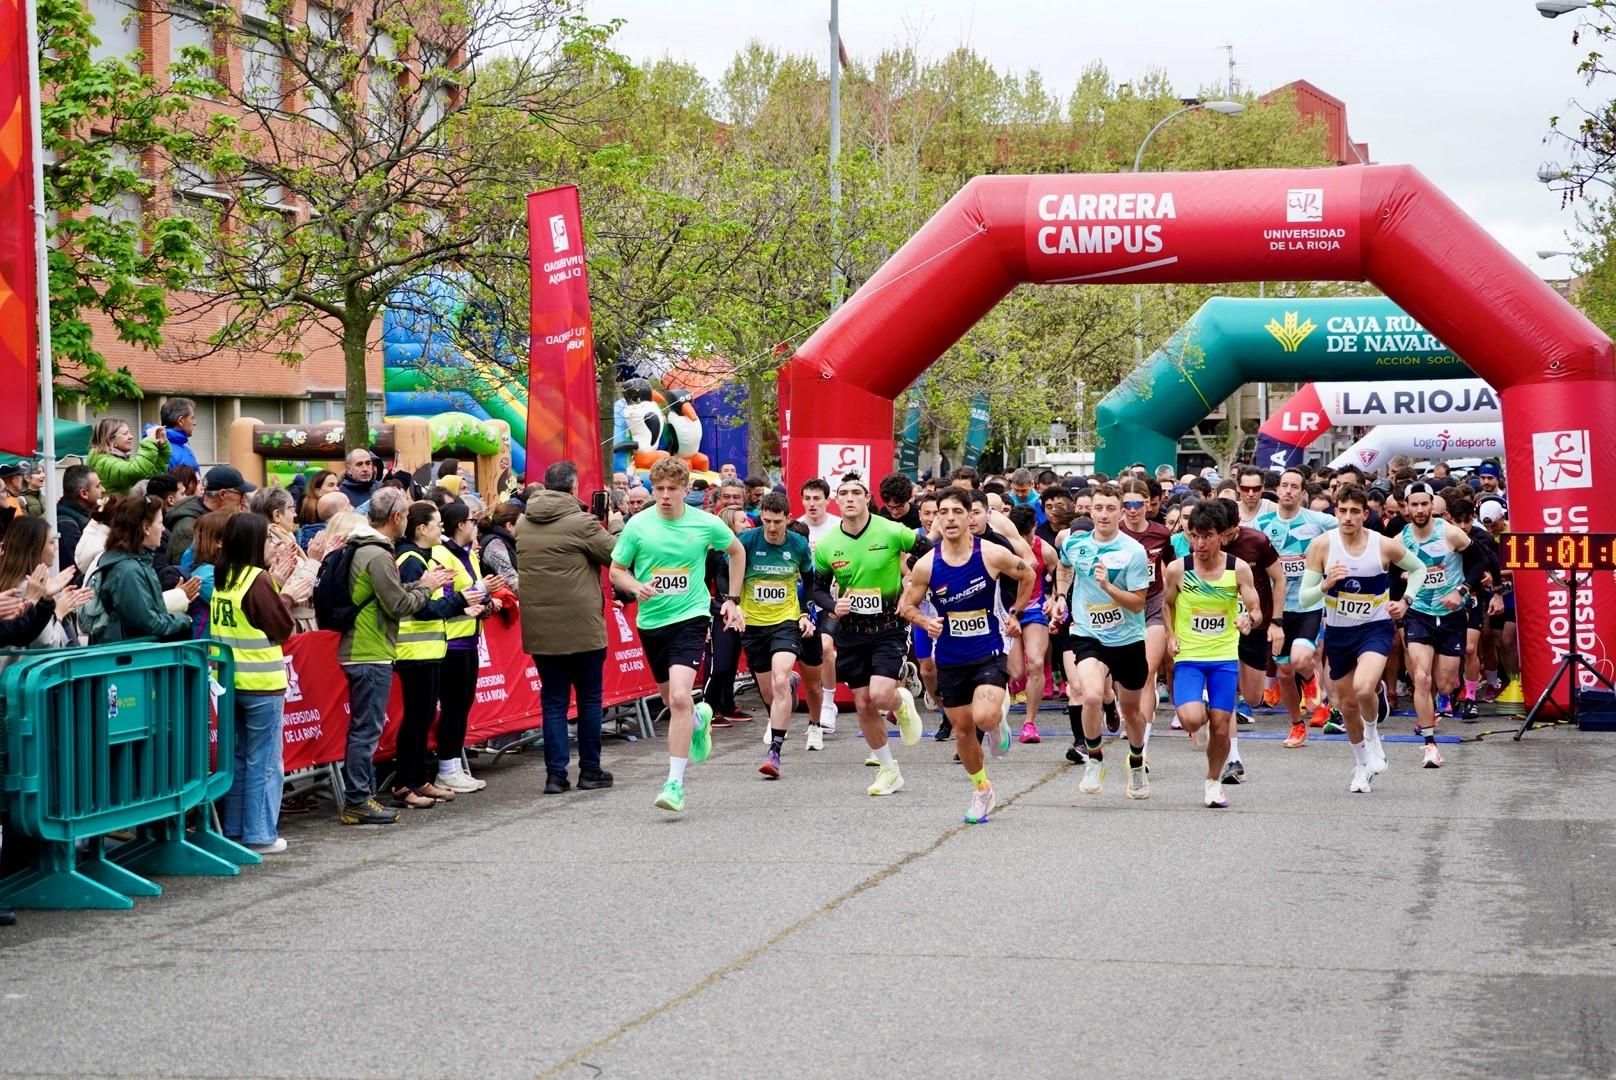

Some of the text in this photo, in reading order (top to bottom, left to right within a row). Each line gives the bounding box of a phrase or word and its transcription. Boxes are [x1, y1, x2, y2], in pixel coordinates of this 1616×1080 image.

[1038, 192, 1176, 221] CARRERA
[1038, 224, 1163, 255] CAMPUS
[1263, 229, 1346, 239] UNIVERSIDAD
[1270, 240, 1340, 251] DE LA RIOJA
[1326, 316, 1382, 334] CAJA
[1326, 334, 1447, 352] DE NAVAR
[1375, 355, 1420, 366] ACCIÓN
[1343, 387, 1498, 415] LA RIOJA
[1282, 411, 1320, 431] LR
[1455, 437, 1497, 449] deporte
[654, 575, 688, 590] 2049
[756, 587, 785, 599] 1006
[849, 595, 880, 609] 2030
[1339, 599, 1371, 615] 1072
[212, 596, 238, 628] UR
[1090, 608, 1122, 625] 2095
[951, 616, 986, 632] 2096
[1193, 617, 1225, 630] 1094
[1546, 590, 1570, 665] RIOJA
[284, 730, 295, 744] DE
[294, 728, 304, 742] LA
